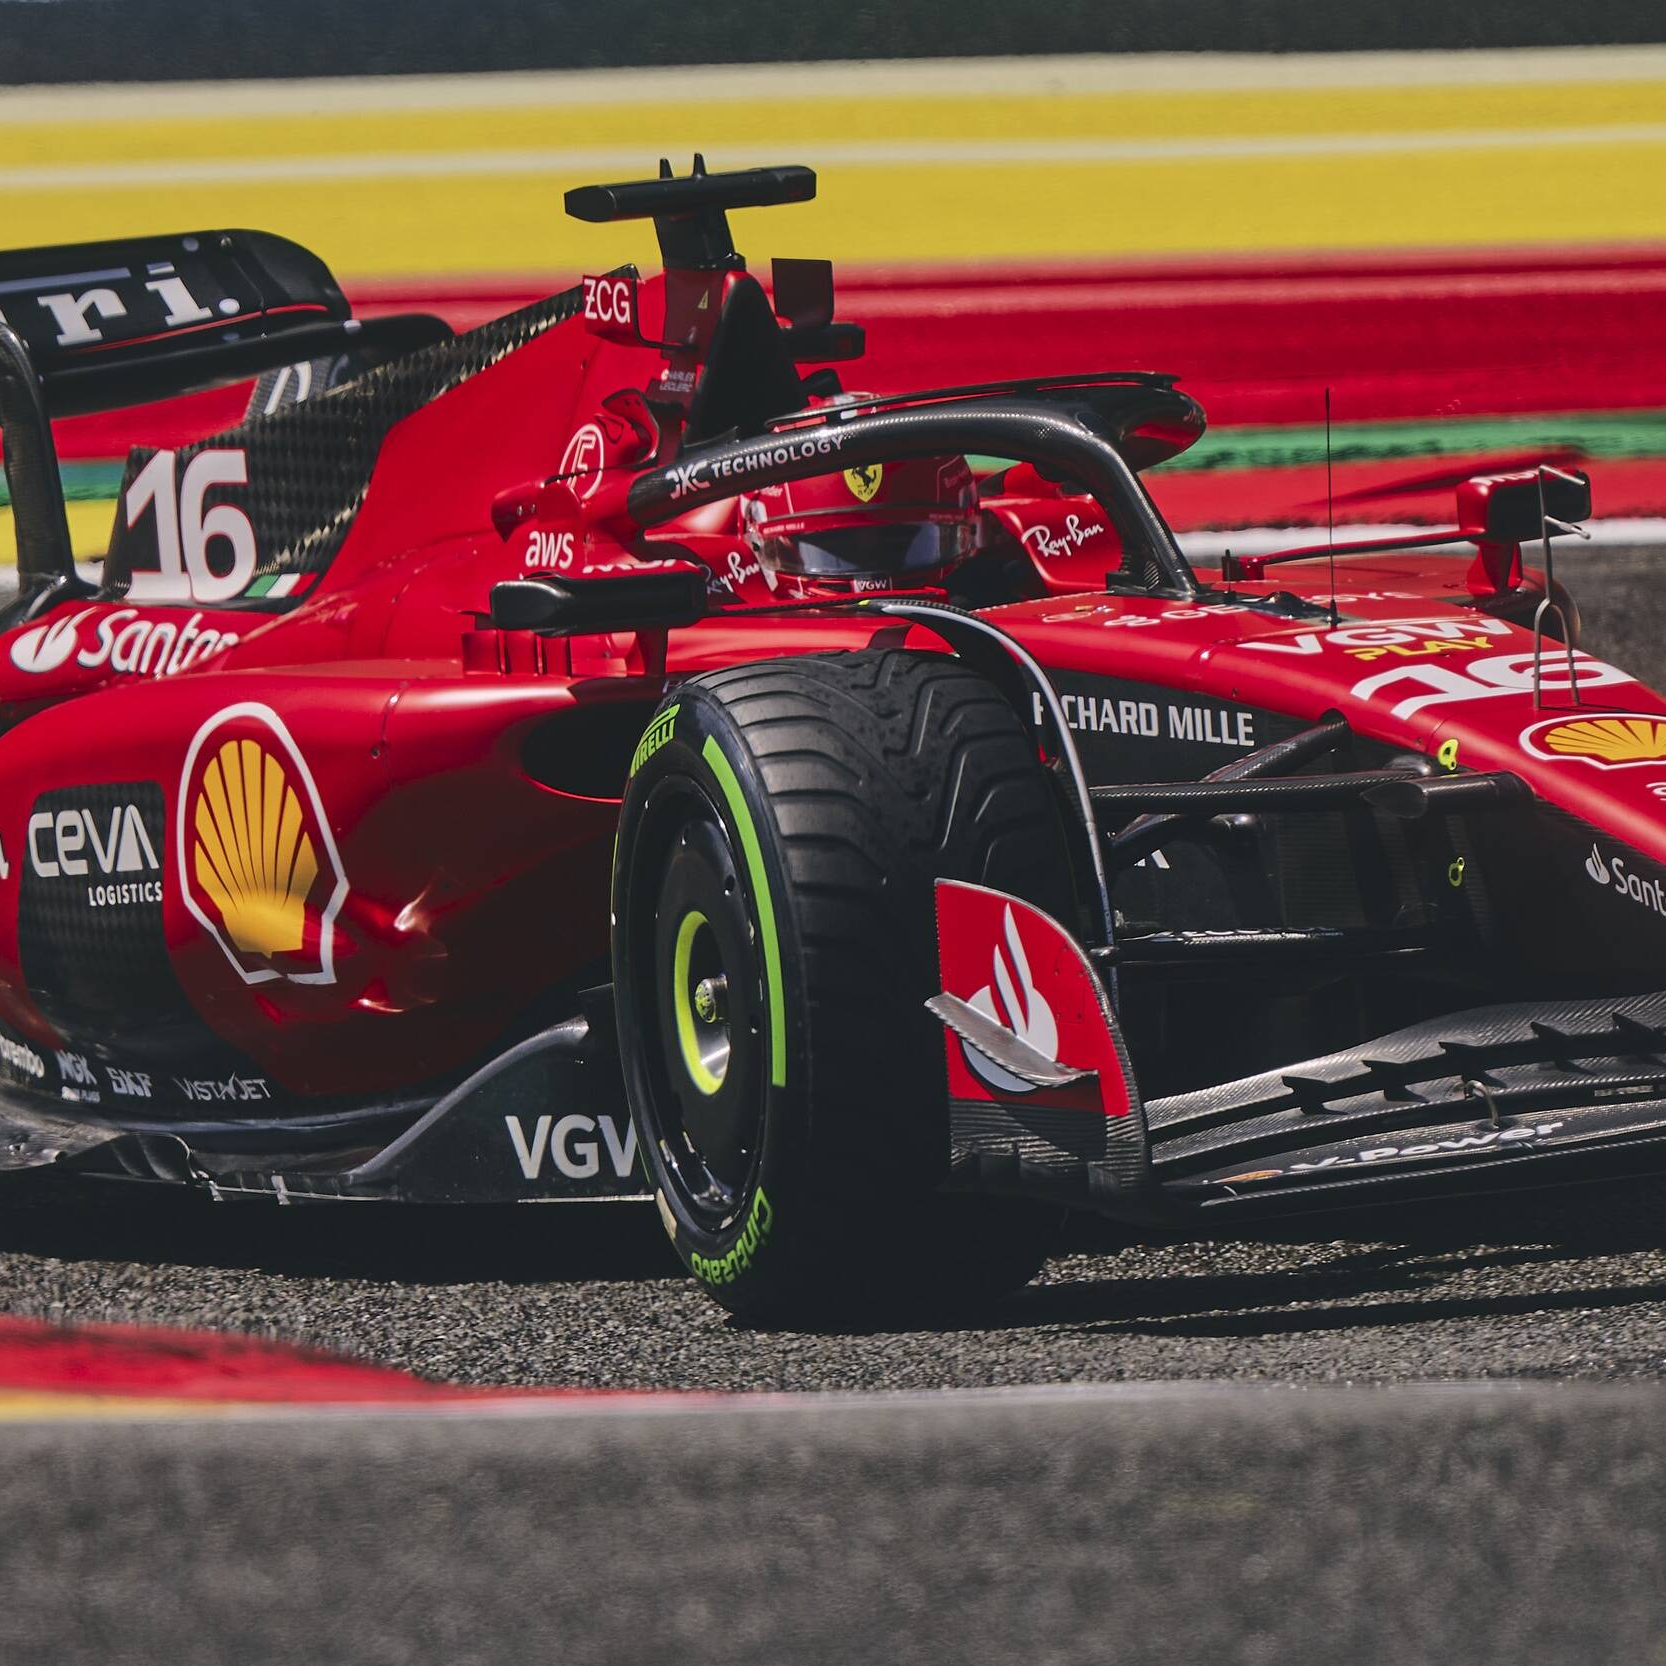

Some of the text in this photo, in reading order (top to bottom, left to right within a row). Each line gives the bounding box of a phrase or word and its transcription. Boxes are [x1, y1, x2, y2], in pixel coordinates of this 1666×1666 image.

[710, 434, 845, 479] TECHNOLOGY
[122, 448, 257, 603] 16
[524, 530, 575, 569] aws
[857, 577, 887, 591] VGW
[1236, 617, 1514, 656] VGW
[1343, 636, 1495, 662] PLAY
[1349, 648, 1641, 721] 16
[629, 703, 681, 779] PIRELLI
[1168, 704, 1255, 747] MILLE
[28, 803, 161, 878] CEVA
[87, 880, 165, 907] LOGISTICS
[105, 1066, 154, 1098] SKF
